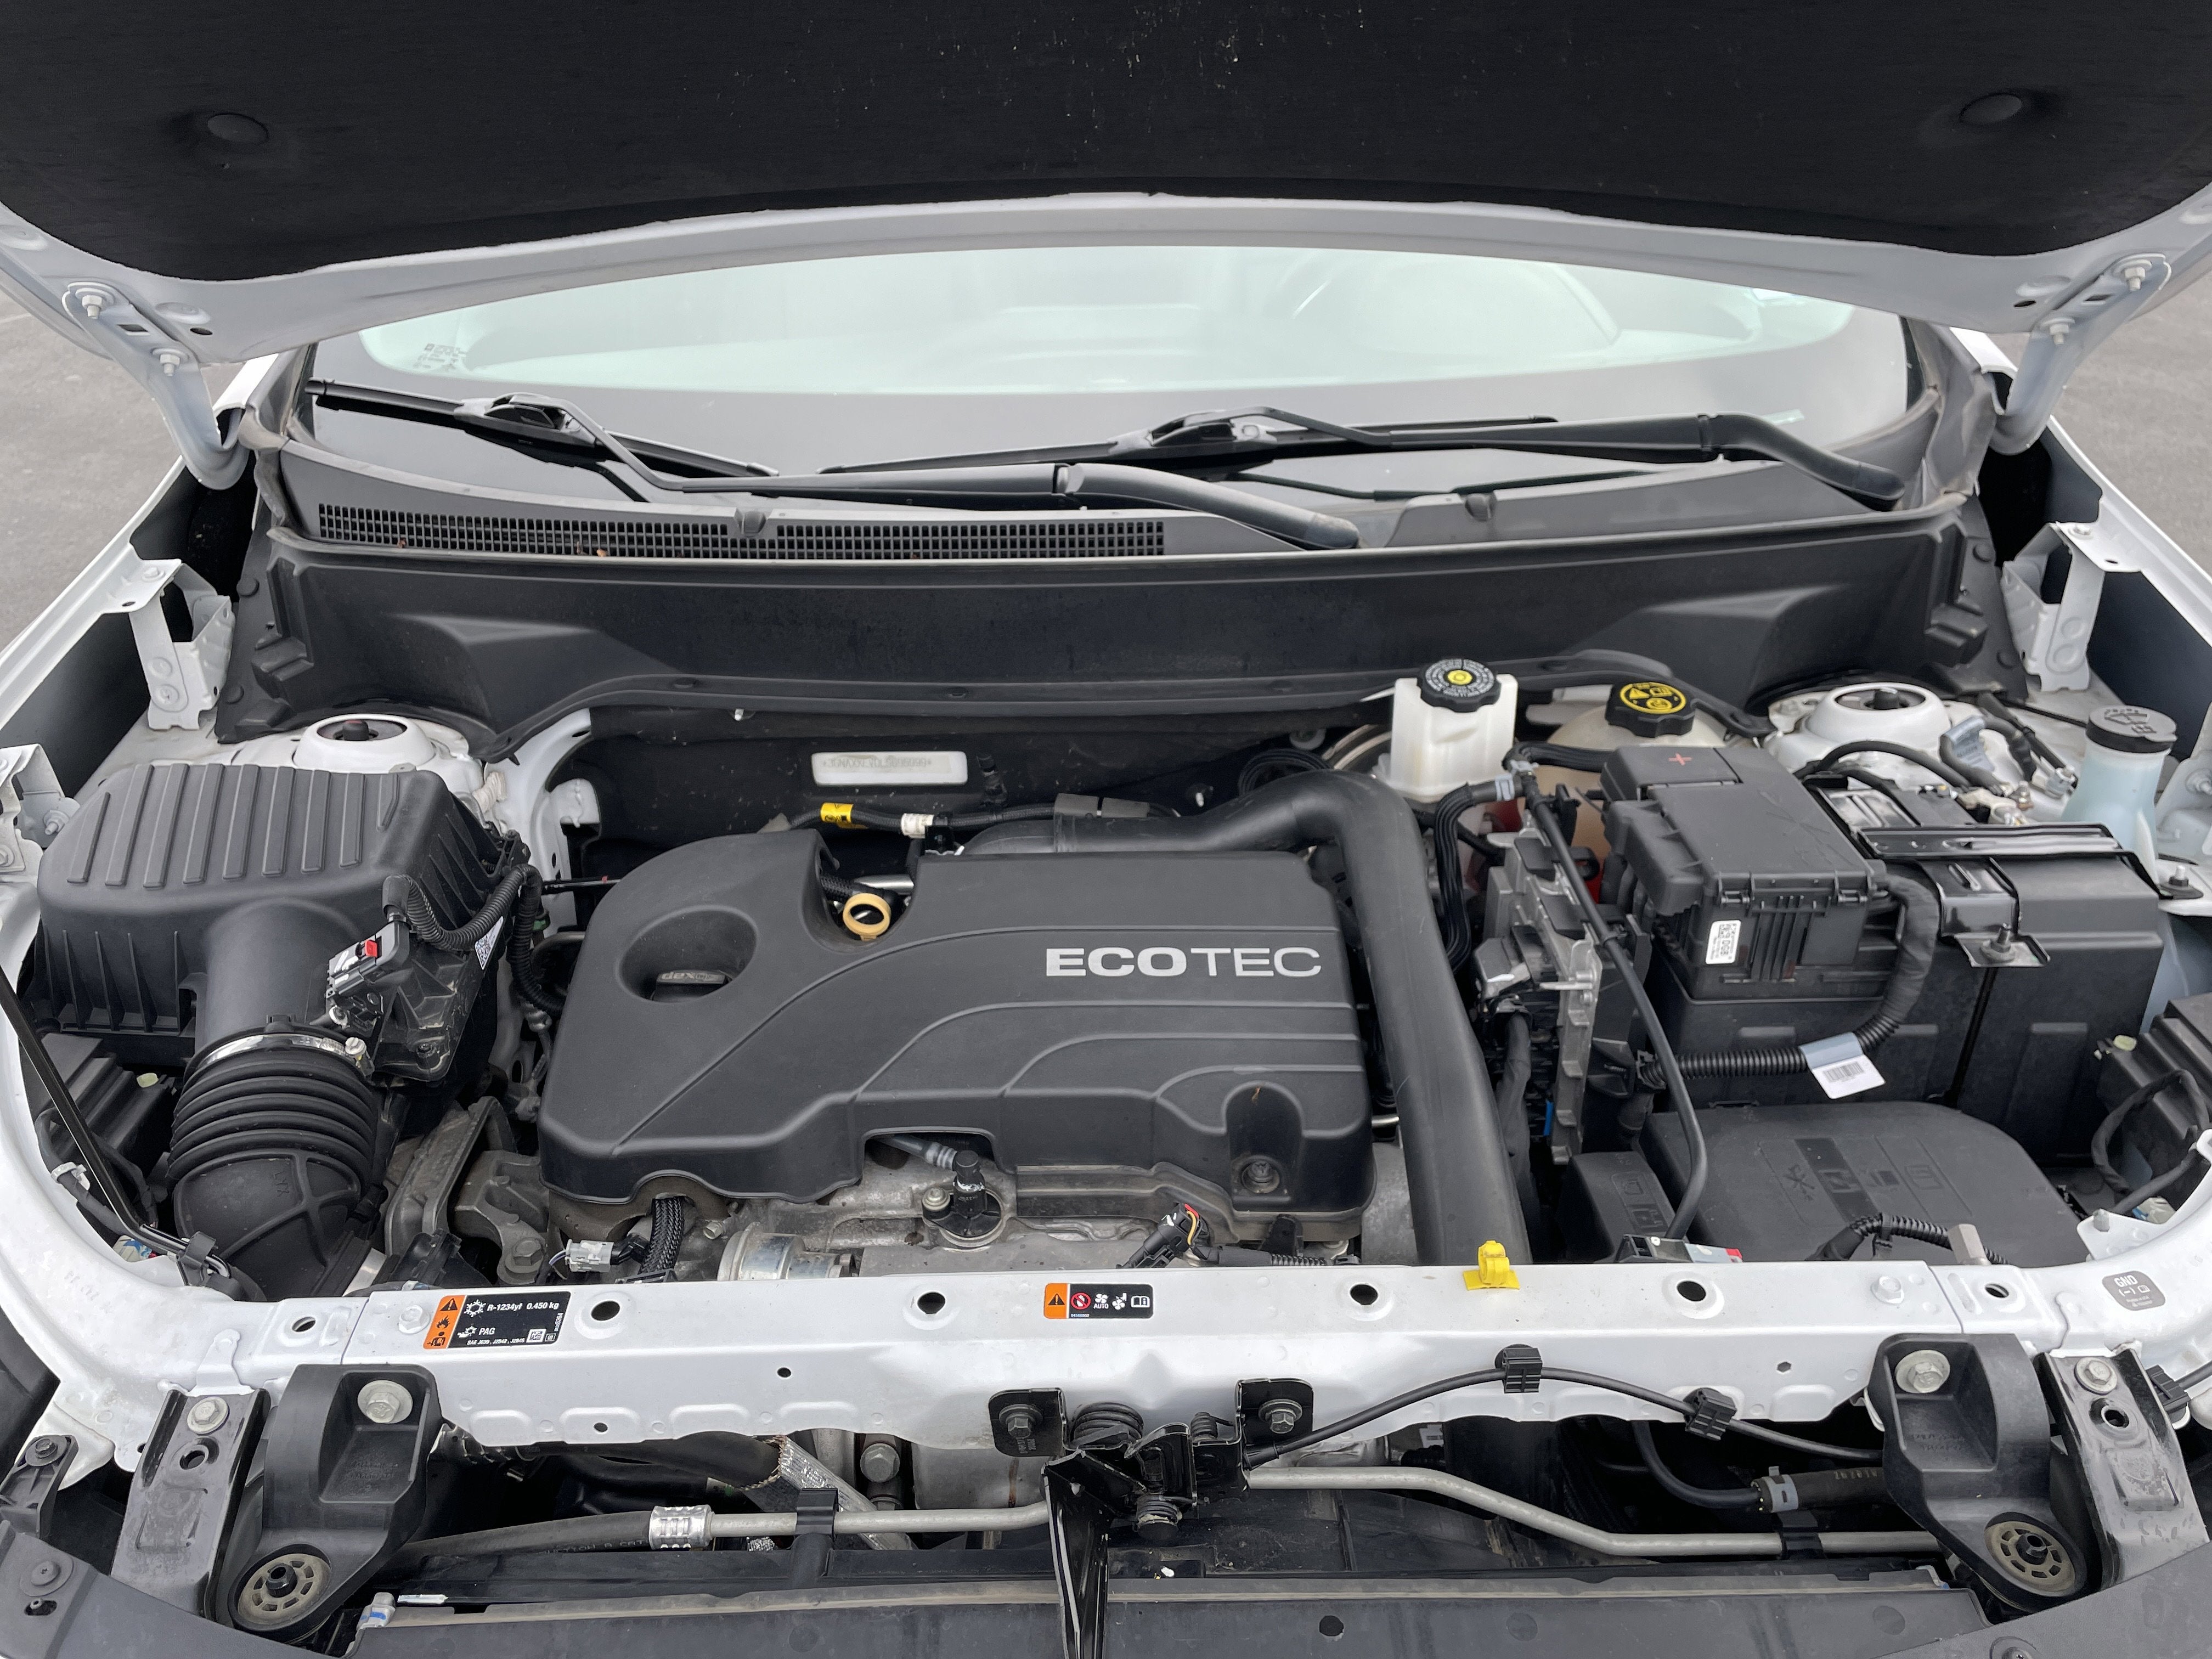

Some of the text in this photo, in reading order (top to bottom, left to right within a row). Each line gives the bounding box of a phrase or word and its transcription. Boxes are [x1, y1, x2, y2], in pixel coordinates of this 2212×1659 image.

[1046, 947, 1322, 977] ECOTEC
[2114, 1274, 2138, 1288] GND
[487, 1302, 523, 1312] R-1234yf
[549, 1301, 560, 1310] kg
[478, 1327, 495, 1335] PAG
